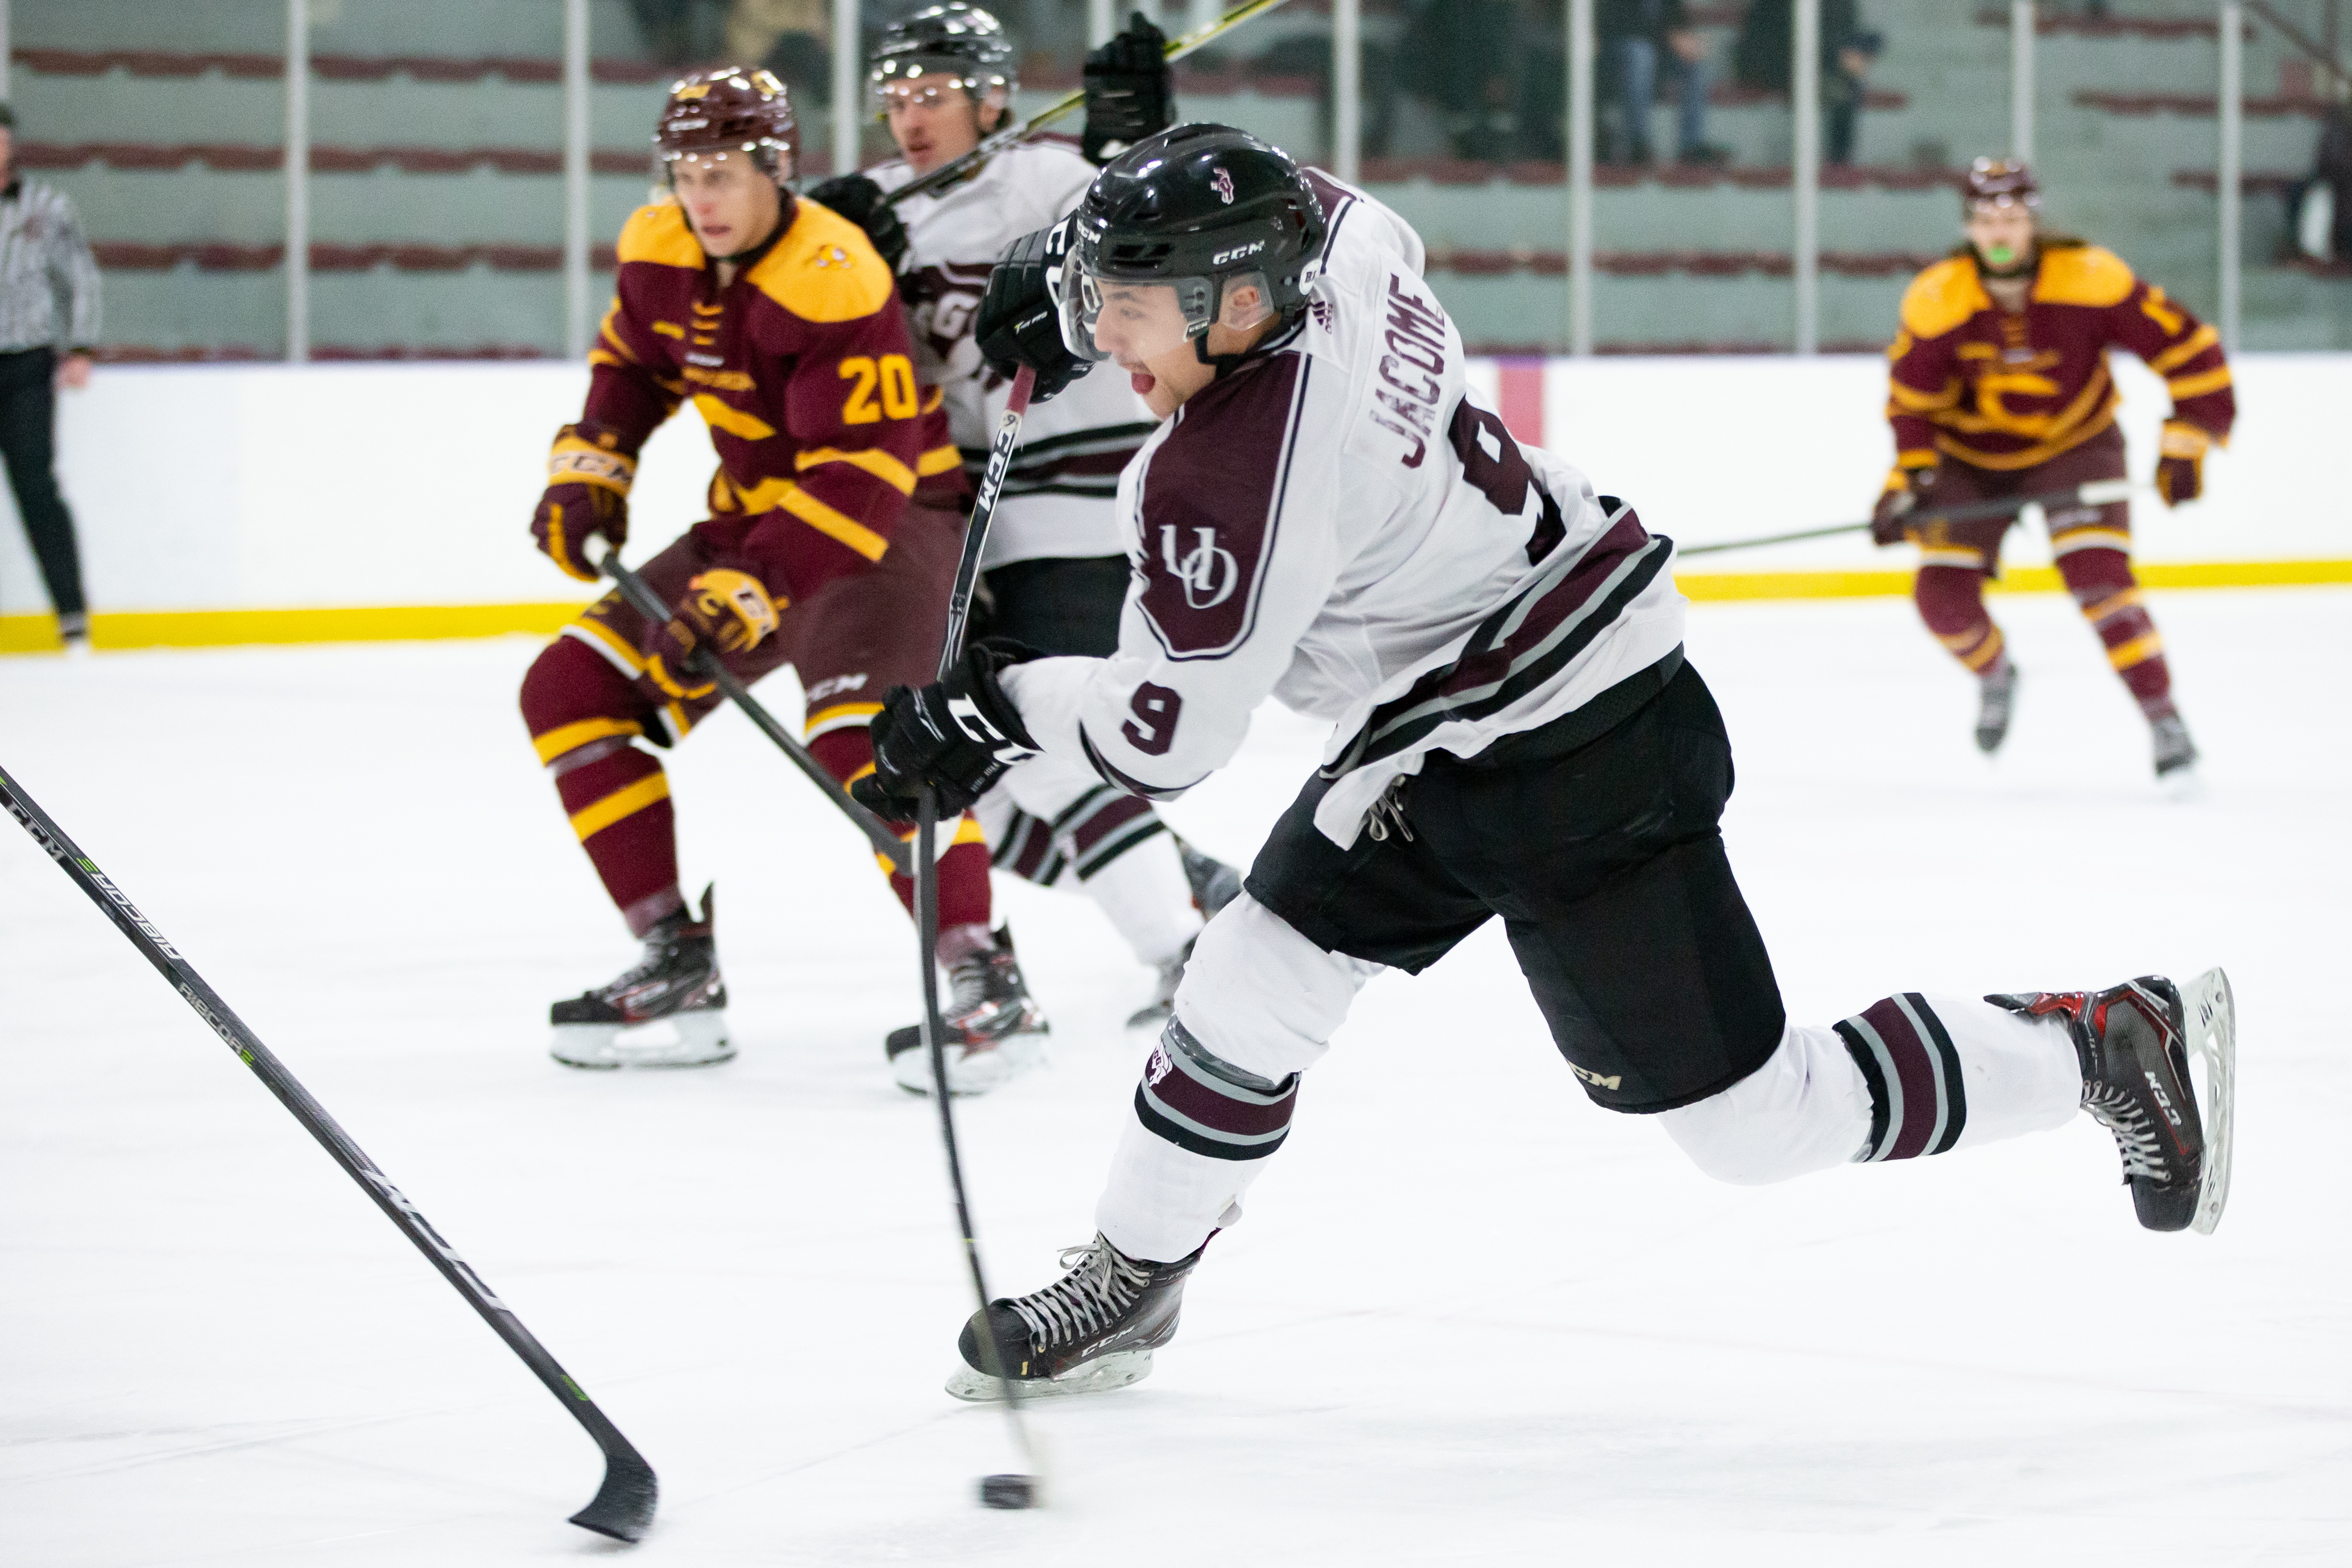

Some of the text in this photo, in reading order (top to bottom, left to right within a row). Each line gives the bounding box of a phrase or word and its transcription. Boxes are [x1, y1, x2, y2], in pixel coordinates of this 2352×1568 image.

[1213, 239, 1265, 265] CCM
[837, 353, 919, 425] 20
[1369, 272, 1445, 469] JACOME
[978, 428, 1014, 512] CCM
[1448, 392, 1567, 567] 9
[1159, 524, 1239, 609] UO
[1121, 681, 1182, 756] 9
[5, 800, 67, 863] CCM
[77, 858, 184, 960] RIBCORE
[179, 982, 255, 1068] RIBCORE
[1564, 1057, 1622, 1090] CM
[2144, 1071, 2182, 1126] CCM
[1081, 1325, 1135, 1358] CCM
